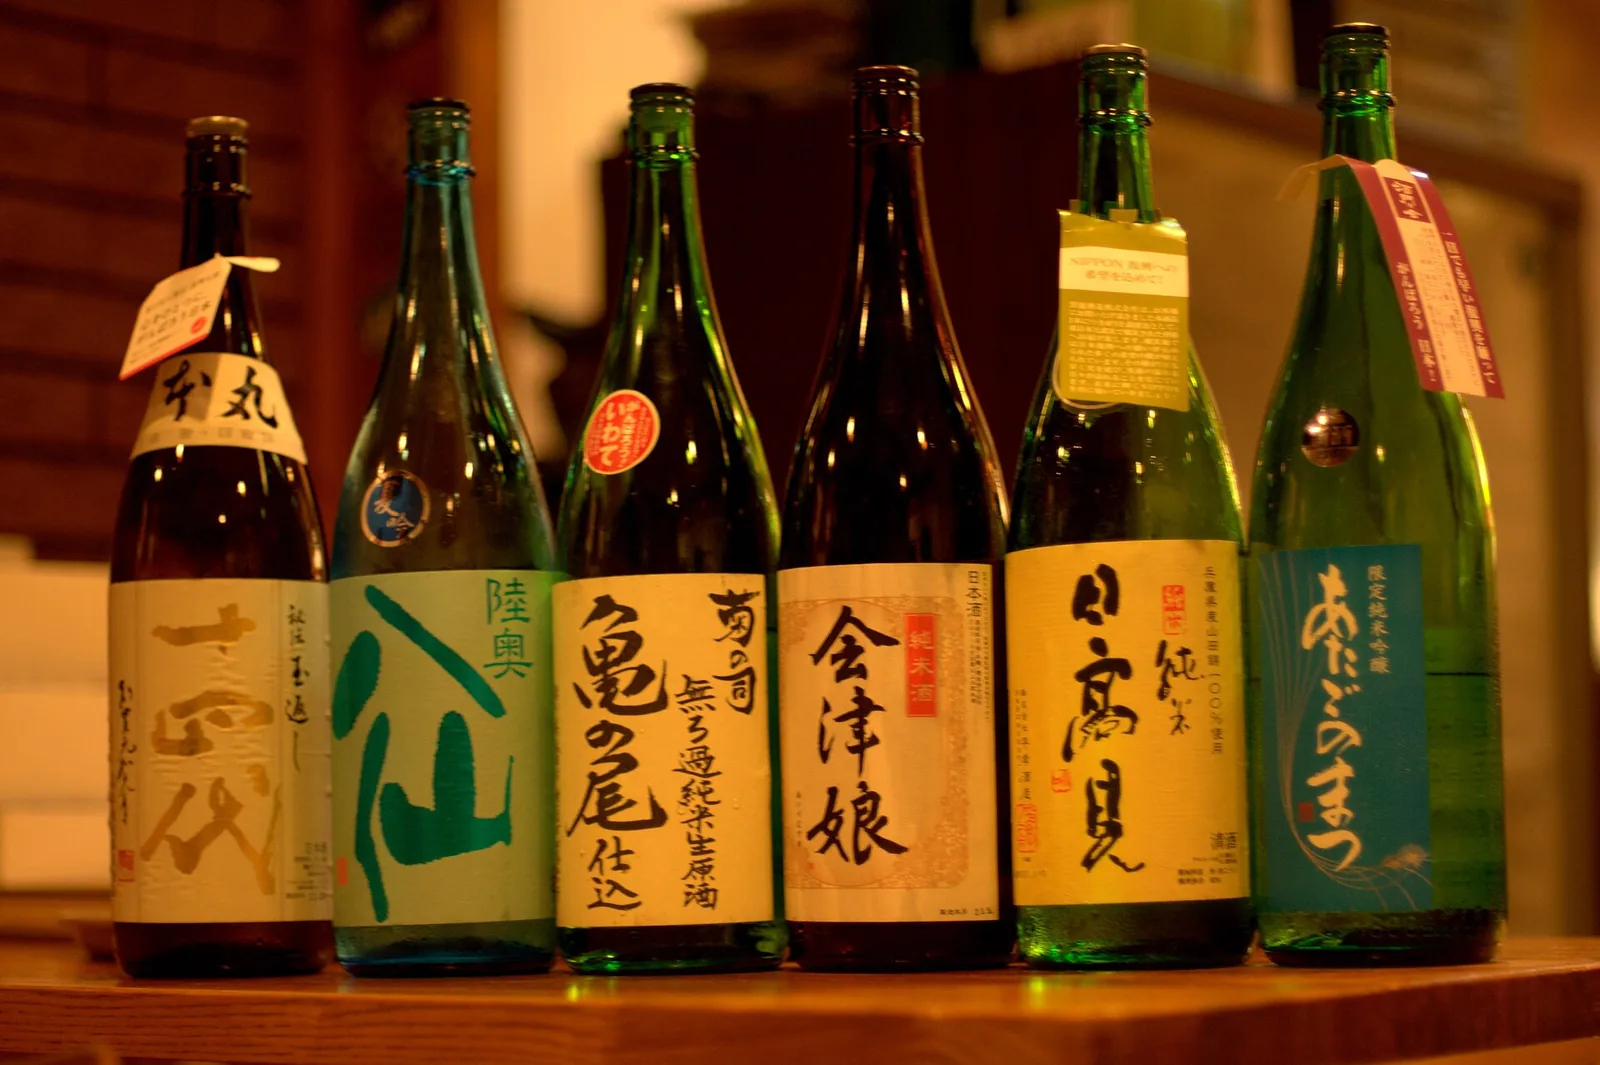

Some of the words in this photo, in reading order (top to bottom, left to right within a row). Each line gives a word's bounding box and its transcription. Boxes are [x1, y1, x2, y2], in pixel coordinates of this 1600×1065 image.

[163, 359, 279, 430] 本丸
[482, 577, 534, 679] 陸奥
[708, 589, 761, 715] 菊の司
[908, 630, 935, 702] 純米酒
[966, 570, 983, 617] 日本酒
[1366, 563, 1392, 674] 限定純米吟醸
[140, 603, 283, 895] 十四代
[332, 584, 515, 924] 八仙
[566, 594, 669, 911] 亀の尾仕込
[672, 674, 723, 910] 無ろ過純米生原酒
[808, 605, 910, 866] 会津娘
[1062, 563, 1146, 873] 日高見
[1302, 563, 1363, 872] あたごのまつ
